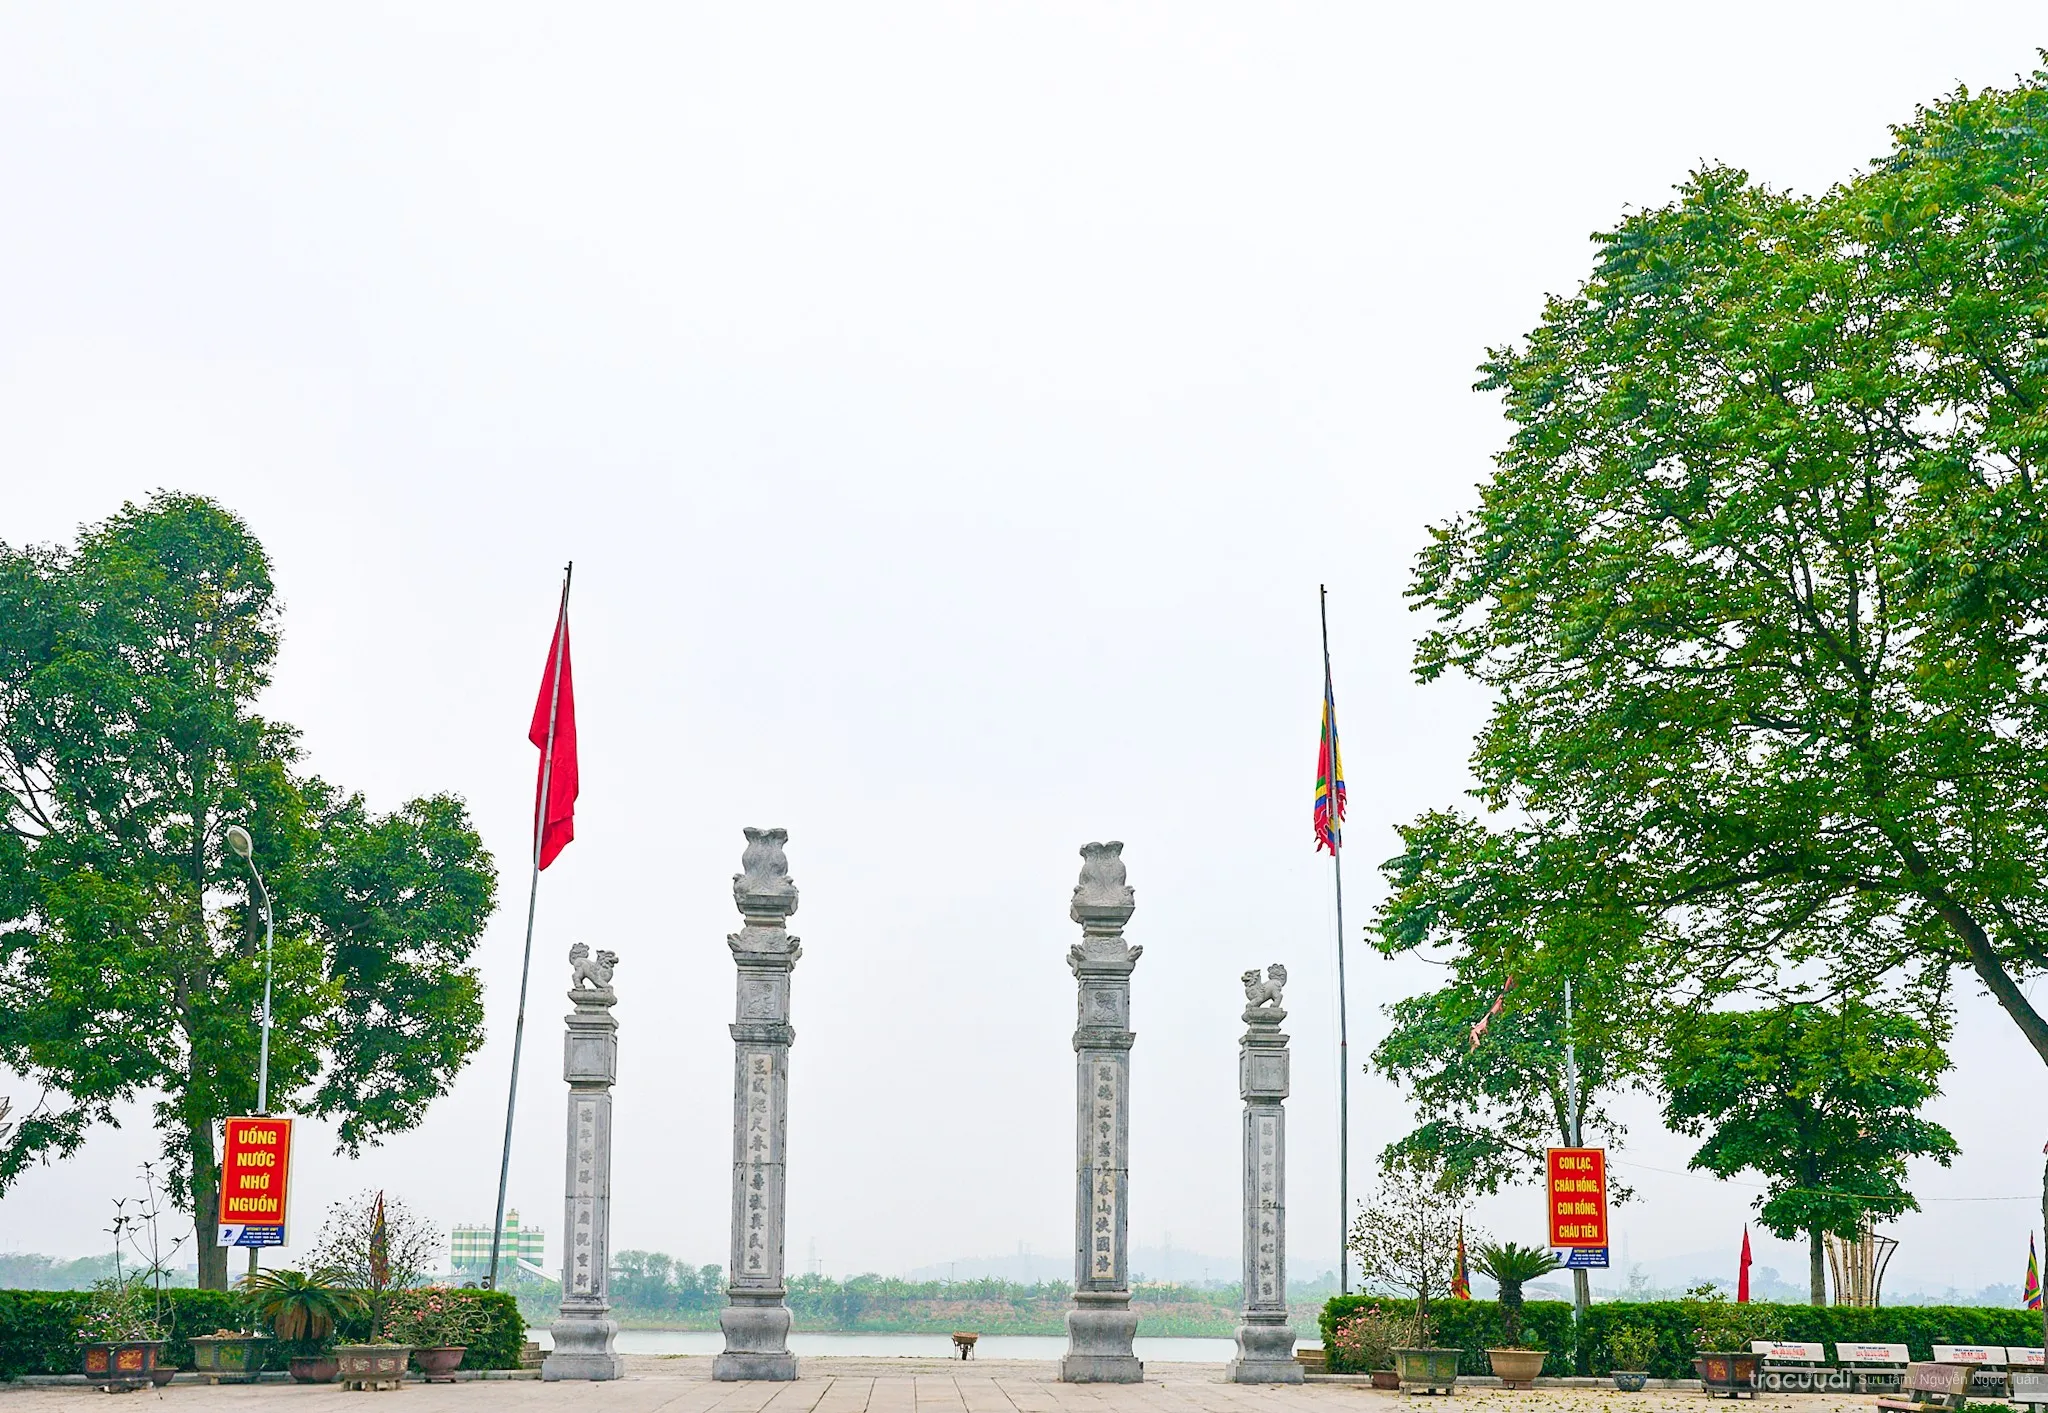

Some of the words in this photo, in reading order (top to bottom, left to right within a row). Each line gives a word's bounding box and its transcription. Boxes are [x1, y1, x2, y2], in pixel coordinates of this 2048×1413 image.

[238, 1125, 277, 1145] UỐNG
[236, 1149, 276, 1168] NƯỚC
[1559, 1156, 1575, 1170] CON
[1576, 1156, 1594, 1173] LẠC,
[239, 1172, 270, 1190] NHỚ
[1554, 1177, 1575, 1192] CHÁU
[228, 1194, 278, 1213] NGUỒN
[1557, 1201, 1574, 1215] CON
[1558, 1222, 1580, 1238] CHÁU
[1580, 1222, 1599, 1238] TIÊN
